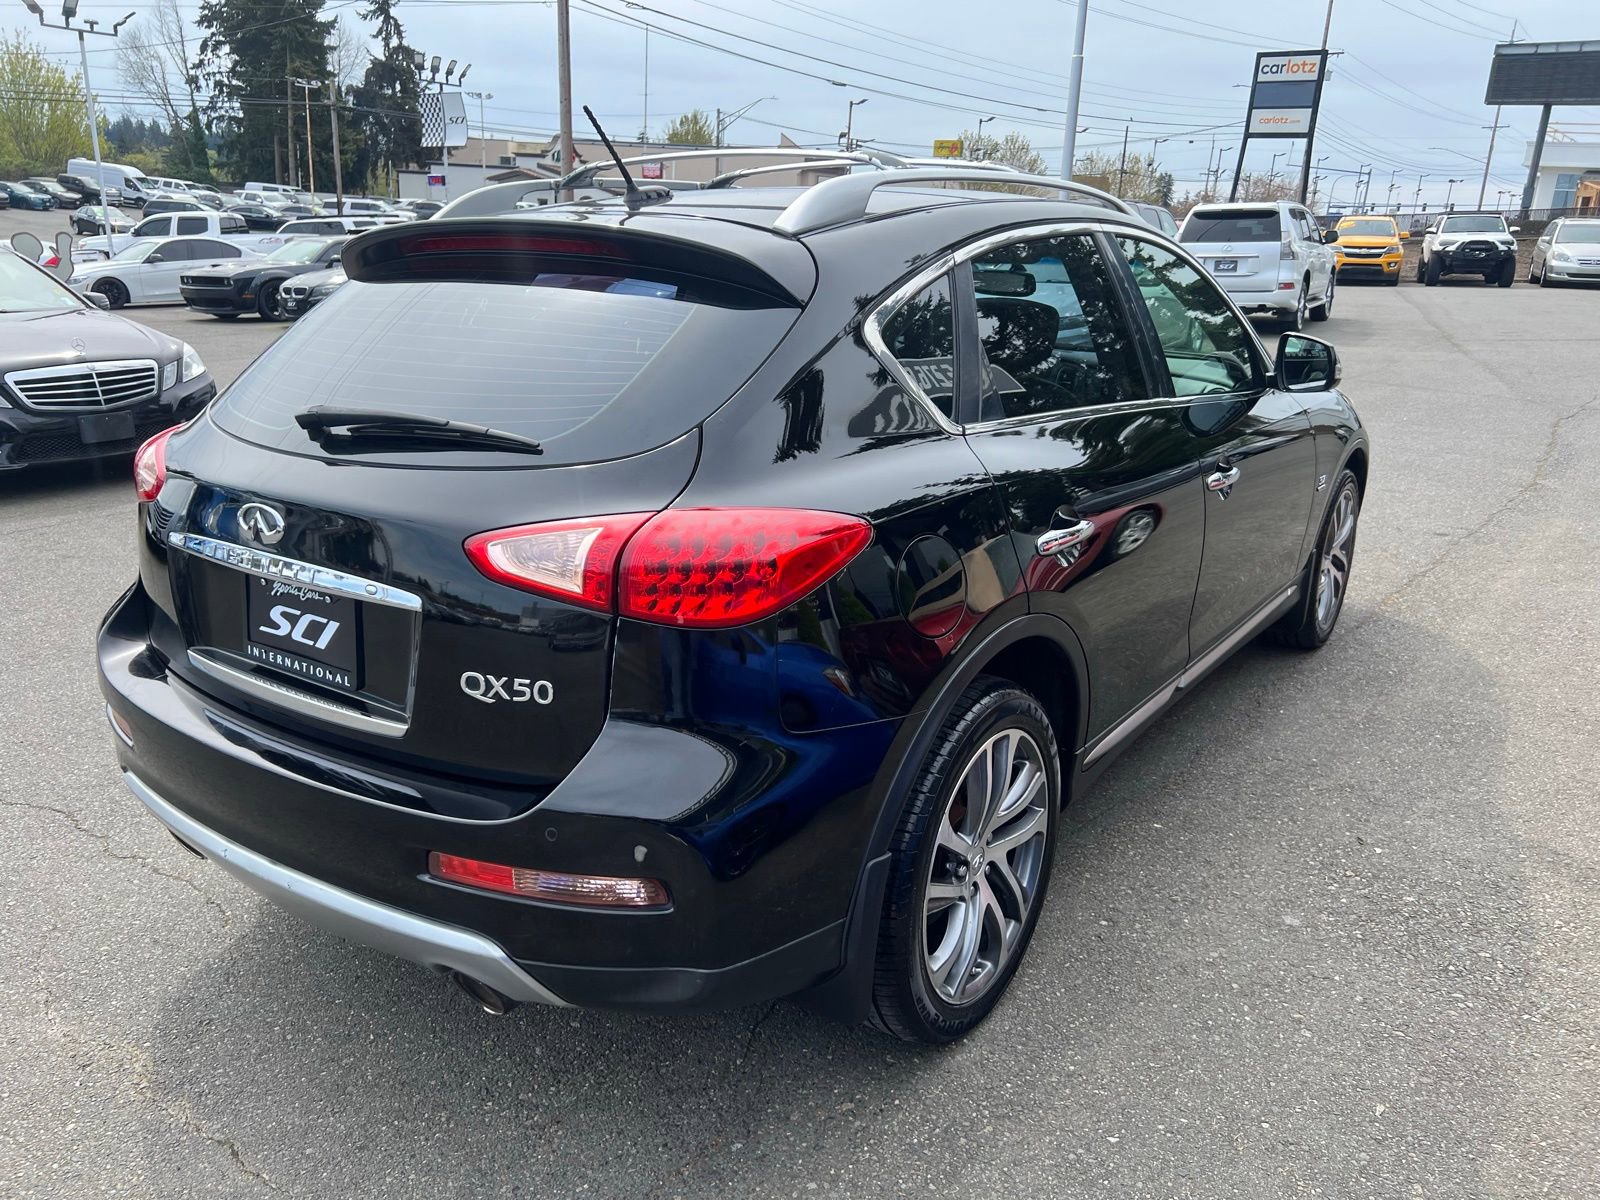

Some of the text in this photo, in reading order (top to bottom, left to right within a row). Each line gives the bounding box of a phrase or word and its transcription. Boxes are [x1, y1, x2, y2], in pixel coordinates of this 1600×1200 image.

[1261, 58, 1317, 75] carlotz
[449, 116, 464, 124] SCI
[271, 580, 323, 600] Sports Cars
[259, 605, 340, 649] SCI
[247, 644, 351, 687] INTERNATIONAL
[460, 671, 554, 704] QX50
